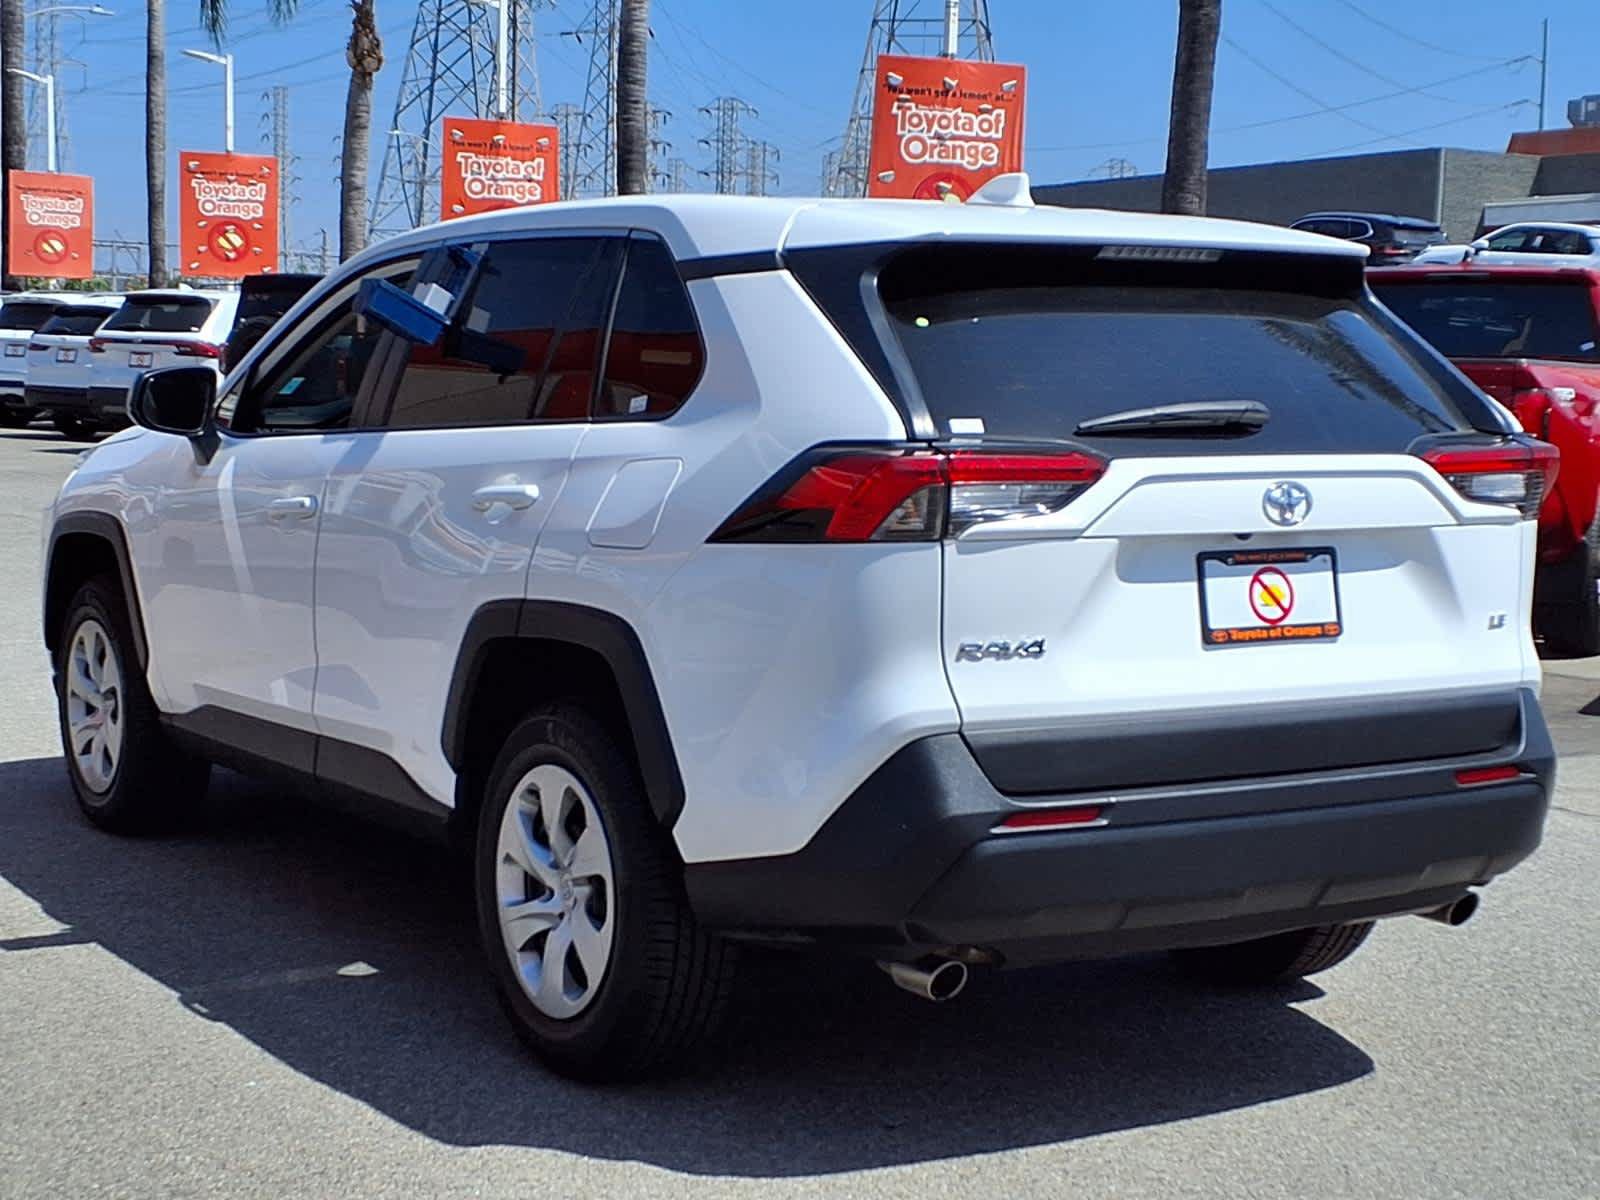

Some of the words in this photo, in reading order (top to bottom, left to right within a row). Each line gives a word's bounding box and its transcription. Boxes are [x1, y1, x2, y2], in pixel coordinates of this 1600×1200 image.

[892, 102, 976, 135] Toyota
[977, 109, 1005, 137] of
[901, 134, 999, 170] Orange
[456, 152, 522, 178] Toyota
[523, 157, 545, 180] of
[191, 179, 248, 200] Toyota
[248, 183, 266, 201] of
[464, 178, 541, 203] Orange
[20, 194, 66, 212] Toyota
[198, 199, 264, 219] Orange
[26, 211, 80, 230] Orange
[1230, 628, 1268, 640] Toyota
[955, 639, 1046, 662] RAV4
